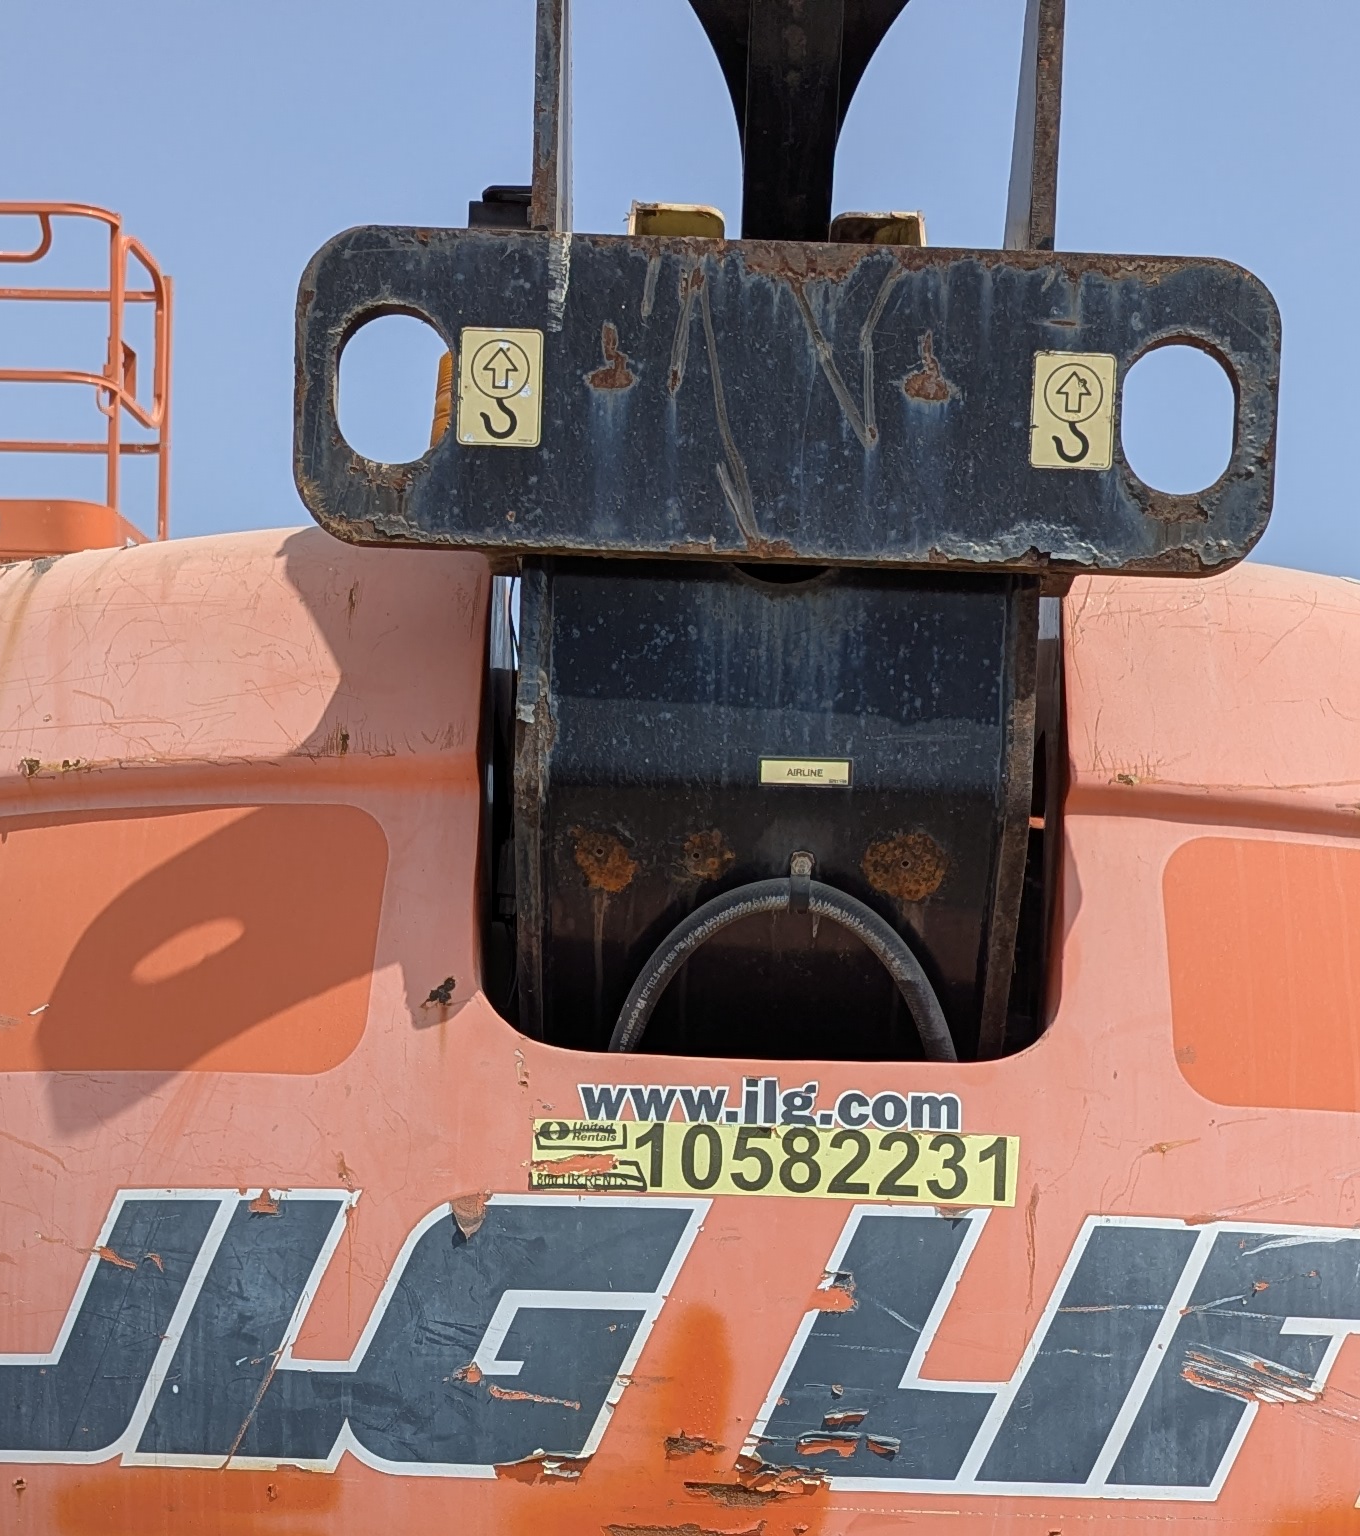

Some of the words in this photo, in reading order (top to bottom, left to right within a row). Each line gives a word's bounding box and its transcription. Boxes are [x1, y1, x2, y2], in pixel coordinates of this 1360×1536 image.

[787, 768, 823, 777] AIRLINE
[577, 1077, 961, 1132] www.jlg.com
[572, 1132, 616, 1142] Rentals
[636, 1122, 1008, 1202] 10582231
